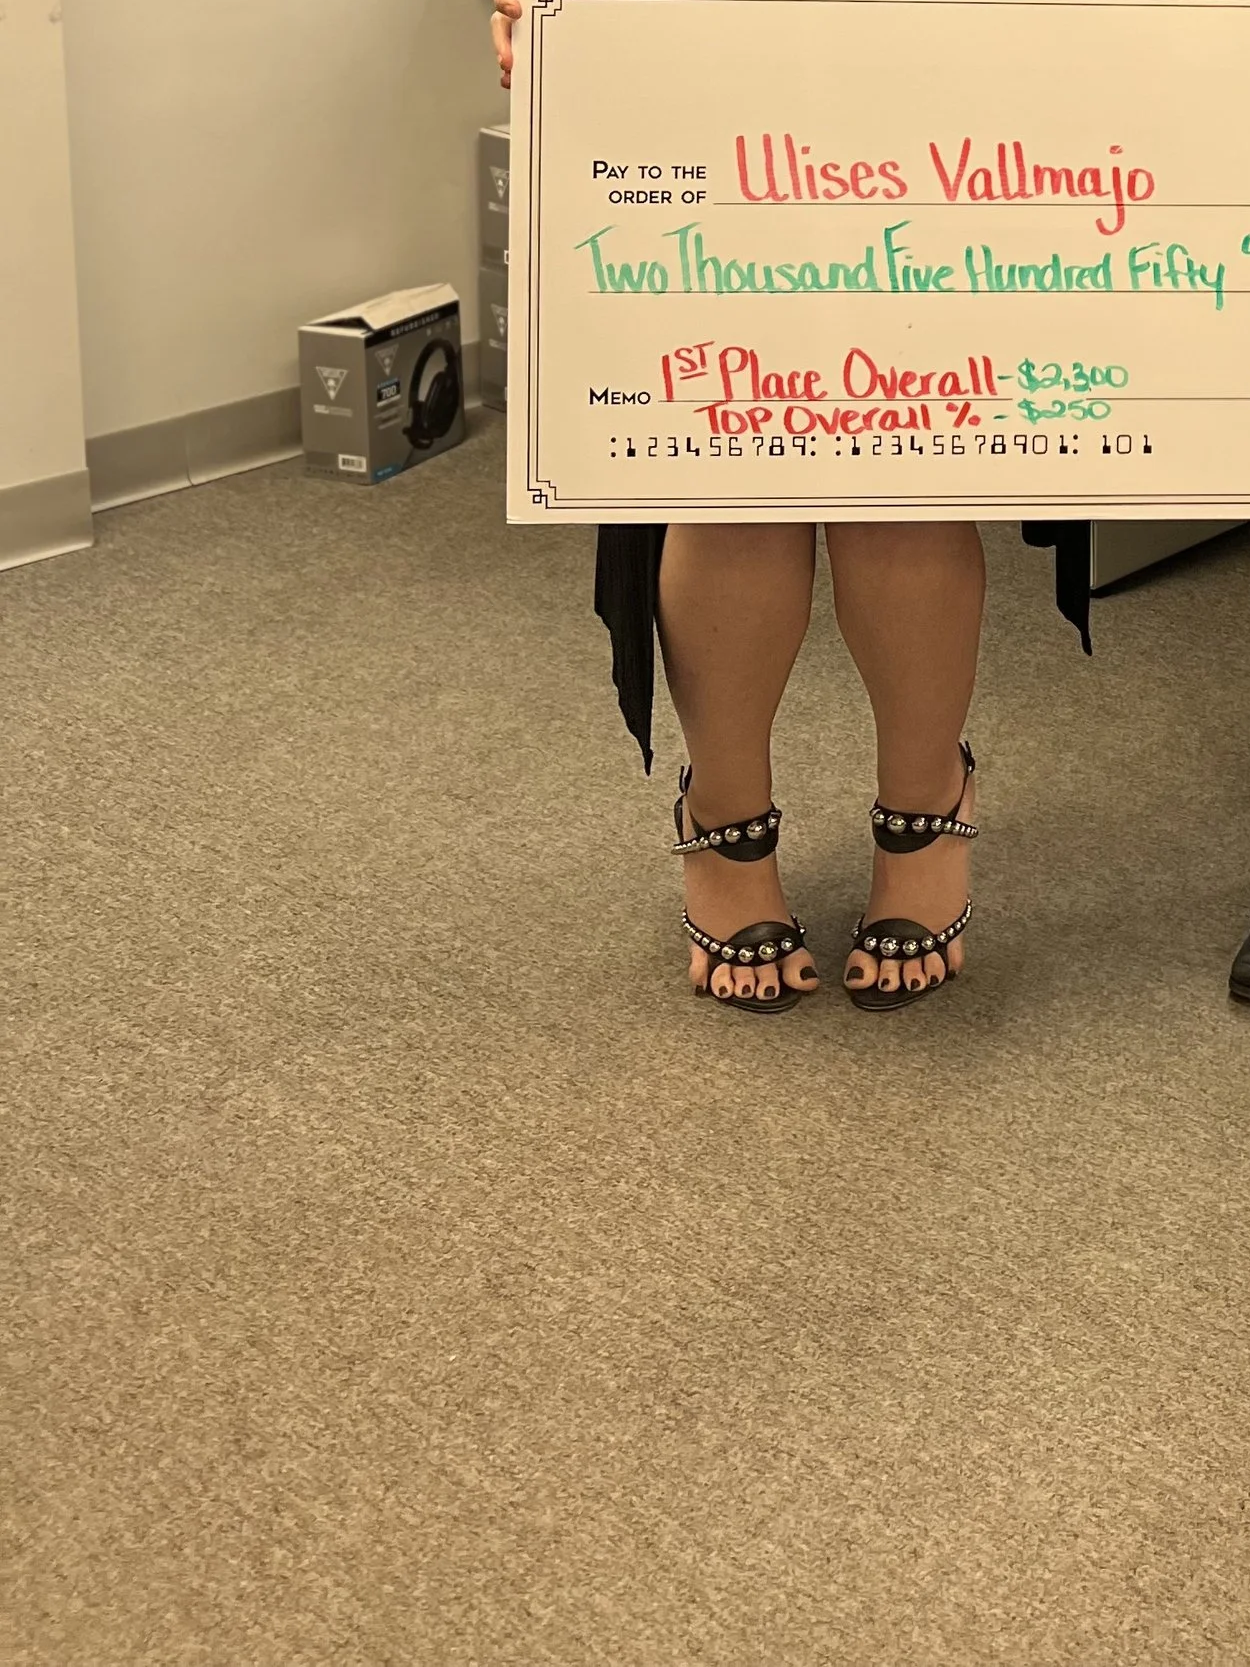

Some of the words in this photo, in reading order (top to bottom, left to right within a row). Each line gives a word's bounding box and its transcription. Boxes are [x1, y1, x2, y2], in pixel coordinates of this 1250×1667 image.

[636, 163, 663, 180] TO
[670, 163, 707, 180] THE
[735, 134, 908, 202] Ulises
[929, 137, 1155, 235] Vallmajo
[608, 188, 674, 205] ORDER
[680, 188, 707, 205] OF
[575, 225, 668, 294] Two
[663, 222, 876, 296] Thousand
[883, 220, 957, 294] Five
[964, 244, 1112, 295] Hundred
[1128, 242, 1225, 310] Fifty
[381, 384, 397, 399] 700
[718, 347, 828, 401] Place
